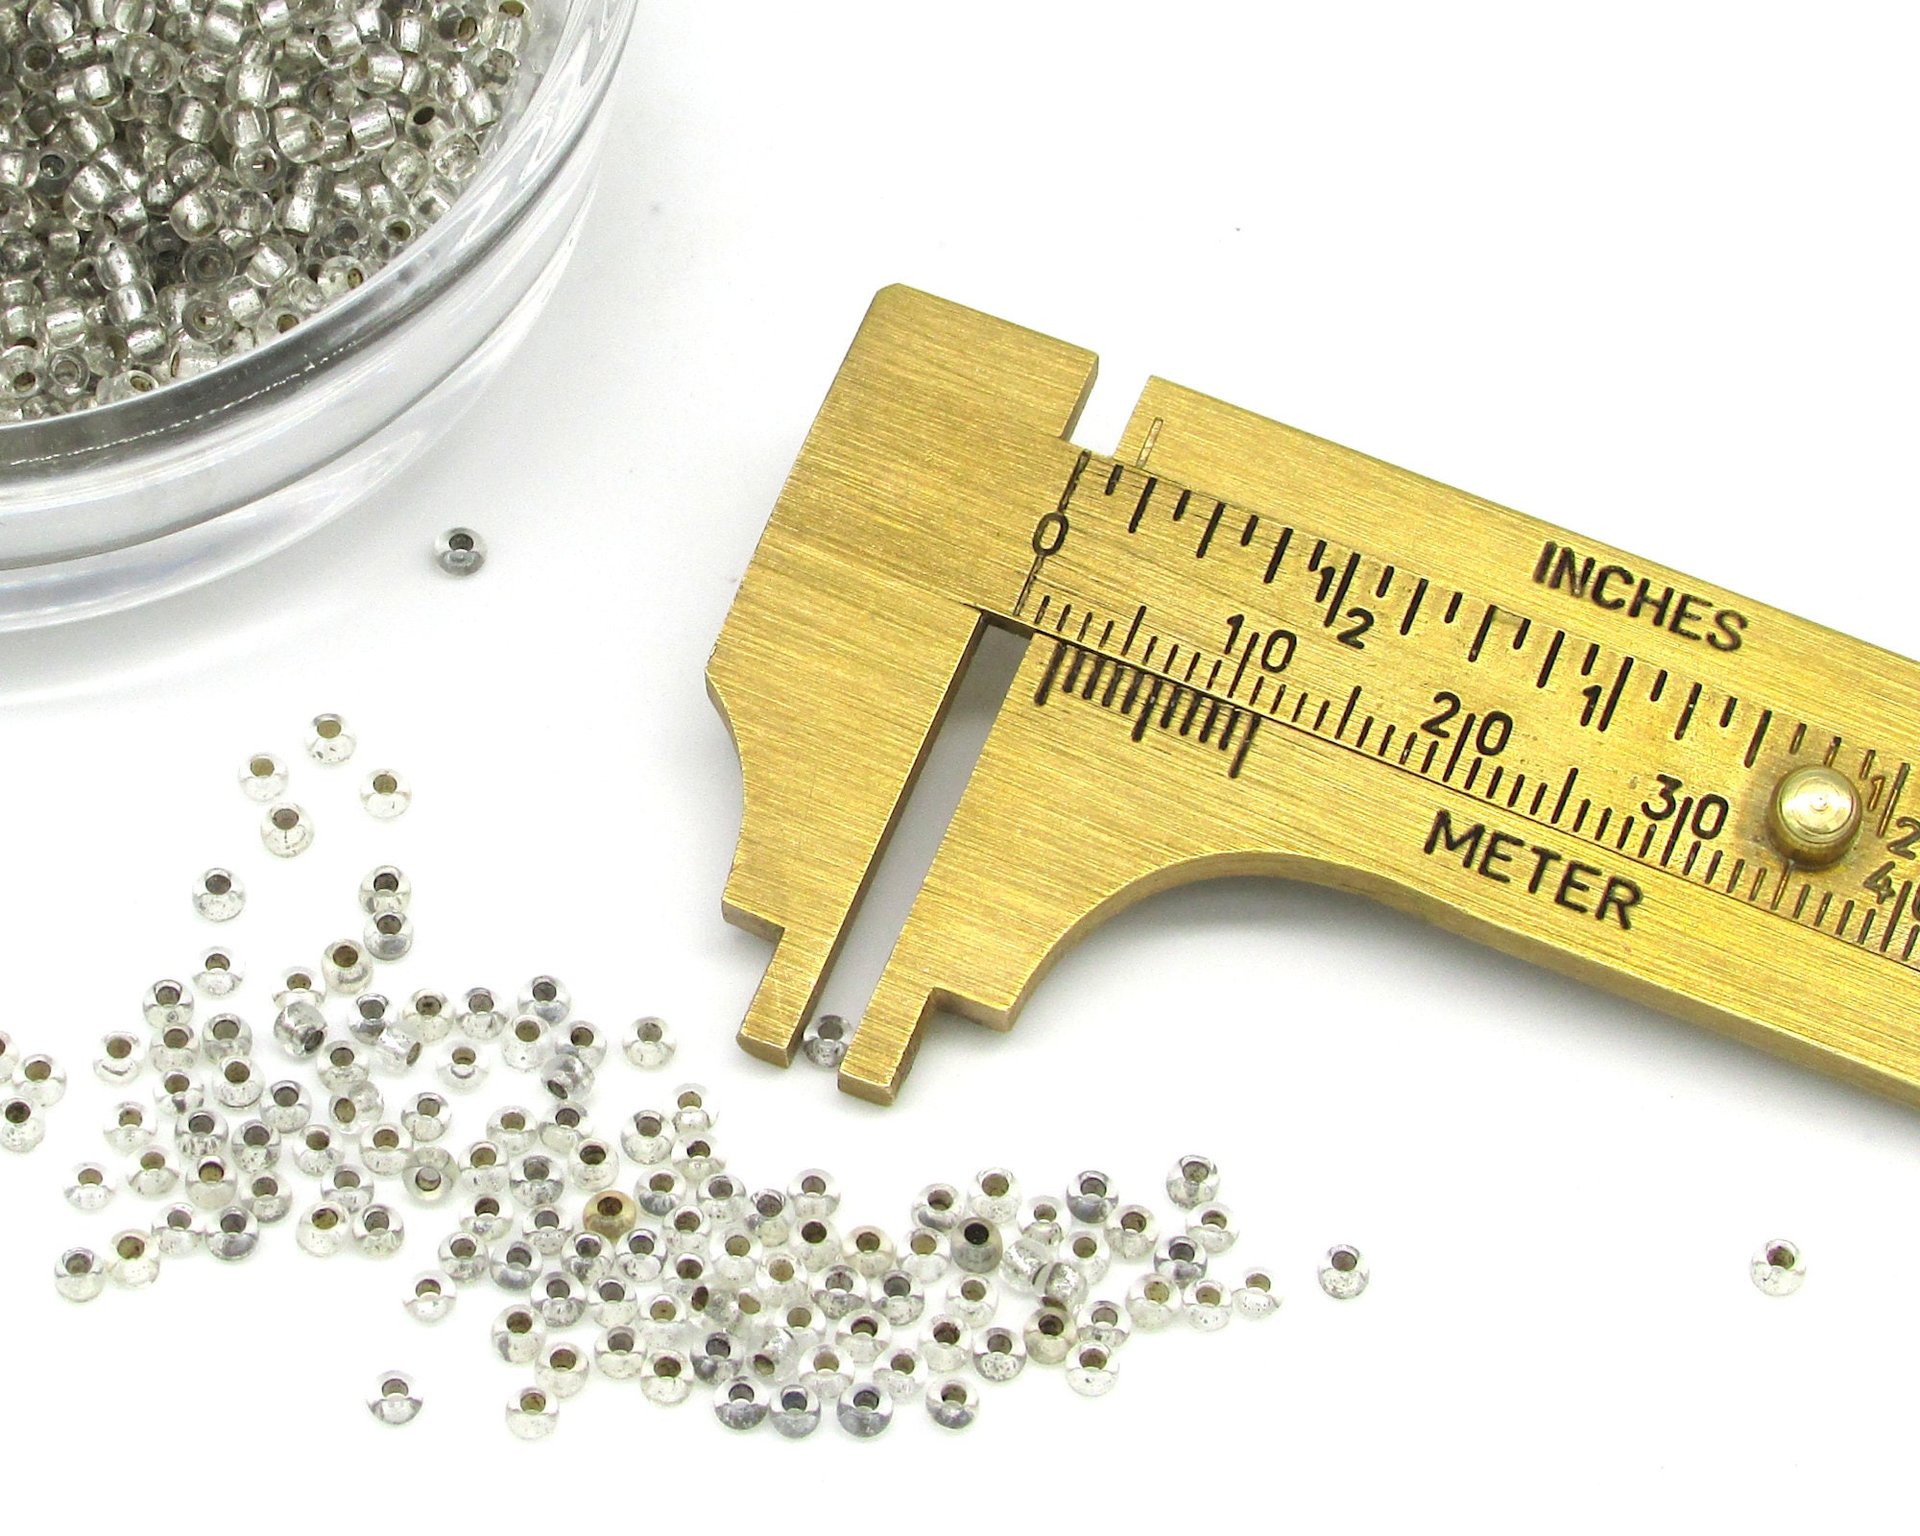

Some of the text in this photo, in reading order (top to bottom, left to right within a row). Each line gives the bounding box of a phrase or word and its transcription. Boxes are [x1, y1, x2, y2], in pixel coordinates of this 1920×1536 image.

[1032, 512, 1069, 557] 0
[1532, 541, 1749, 652] INCHES
[1423, 810, 1644, 930] METER
[1862, 861, 1920, 921] 4
